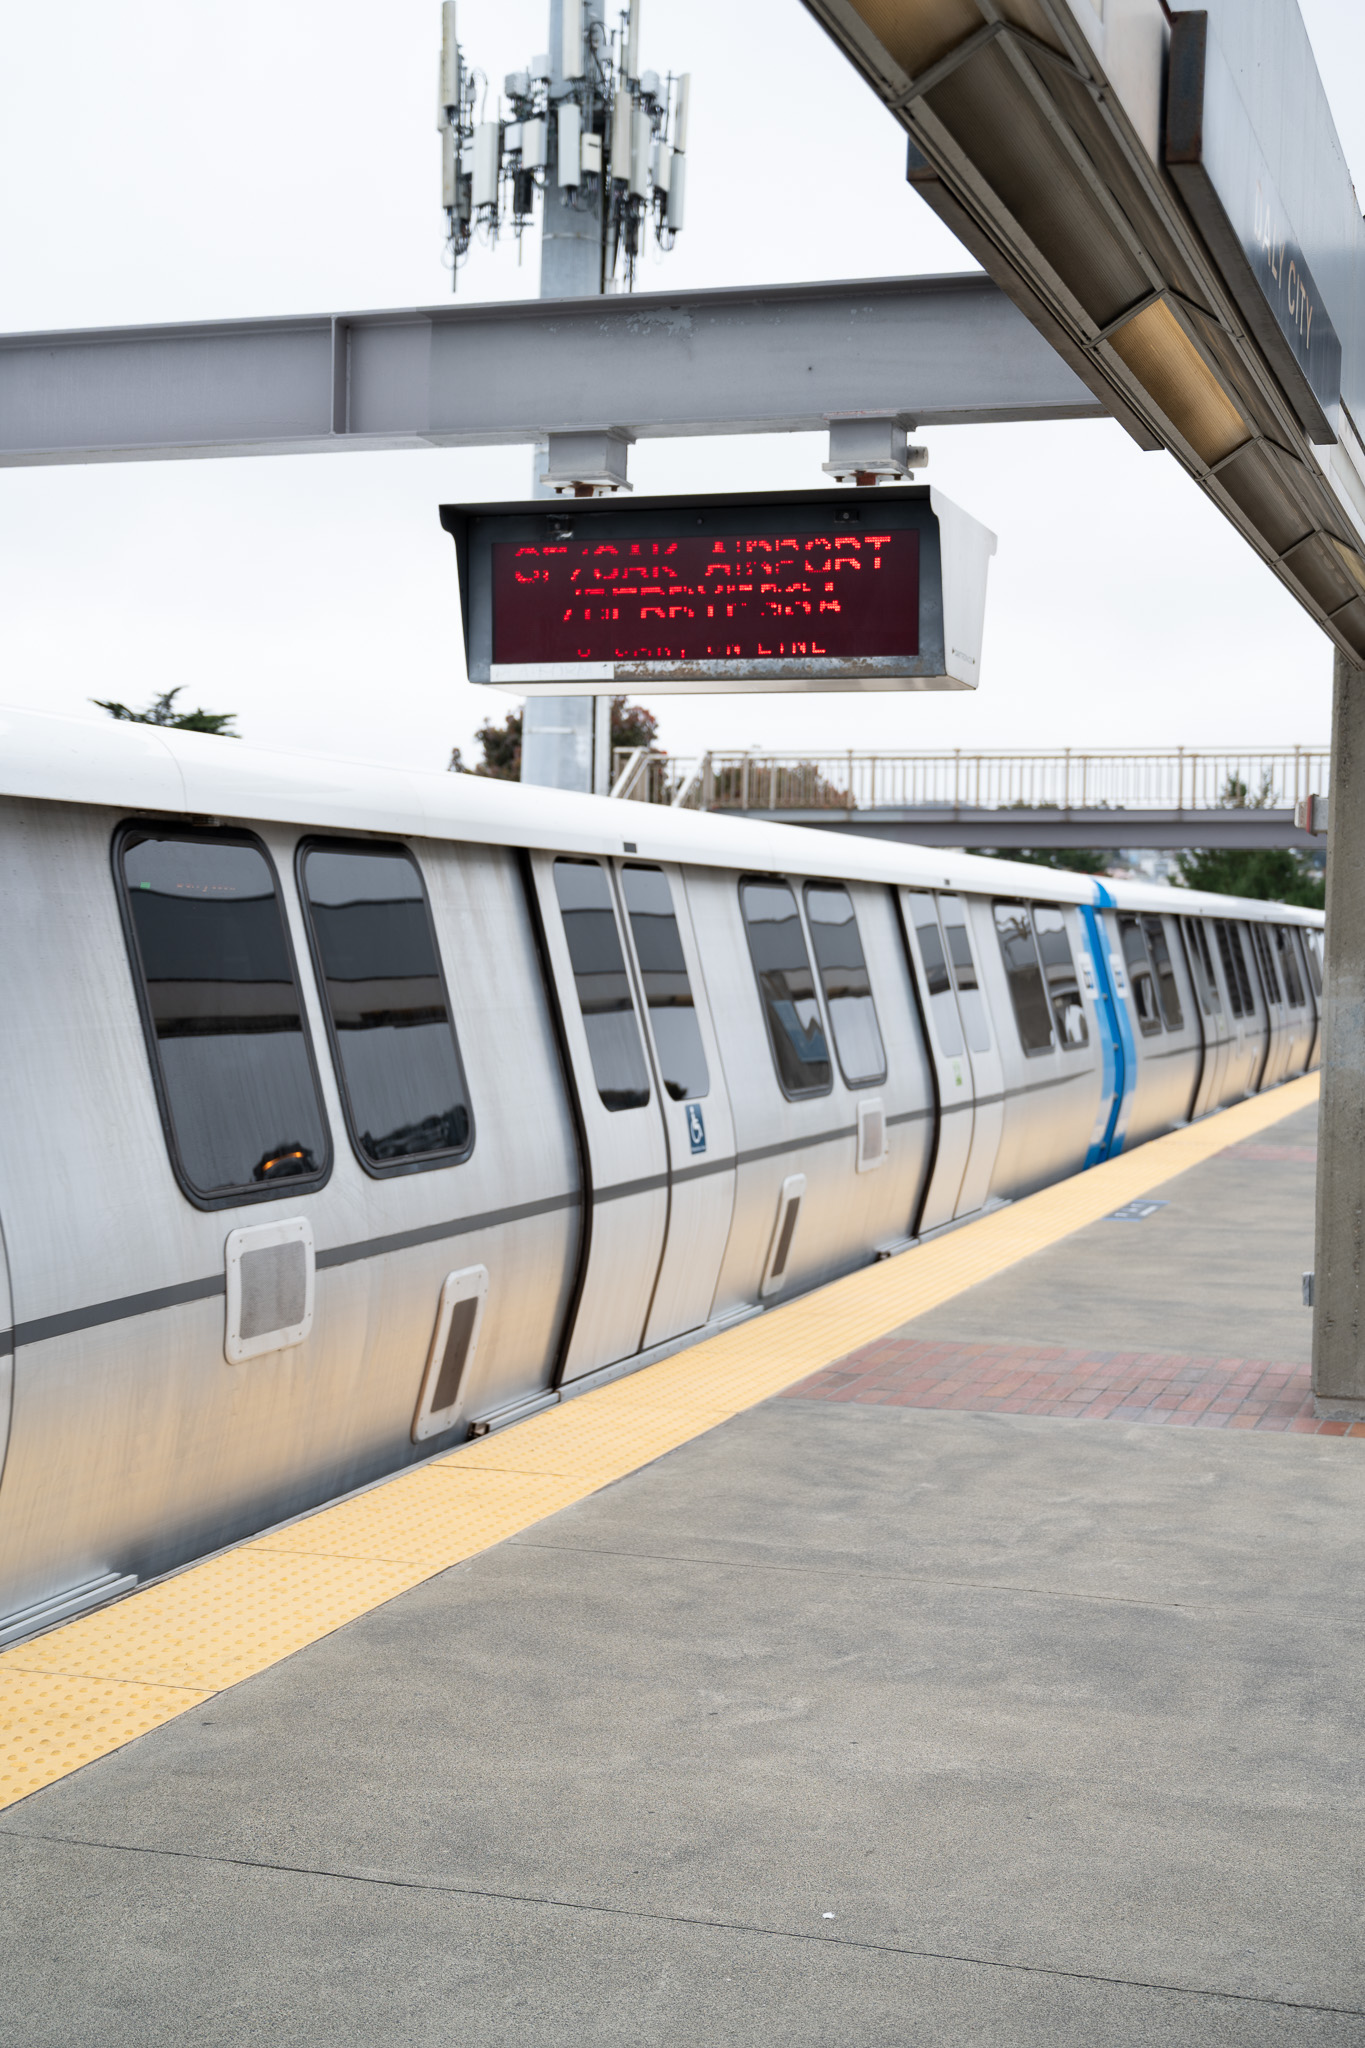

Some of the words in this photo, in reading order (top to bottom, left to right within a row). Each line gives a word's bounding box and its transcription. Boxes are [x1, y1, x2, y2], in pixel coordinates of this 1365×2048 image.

[1254, 180, 1286, 289] DALY
[1288, 260, 1313, 349] CITY
[705, 536, 892, 576] AIRPORT
